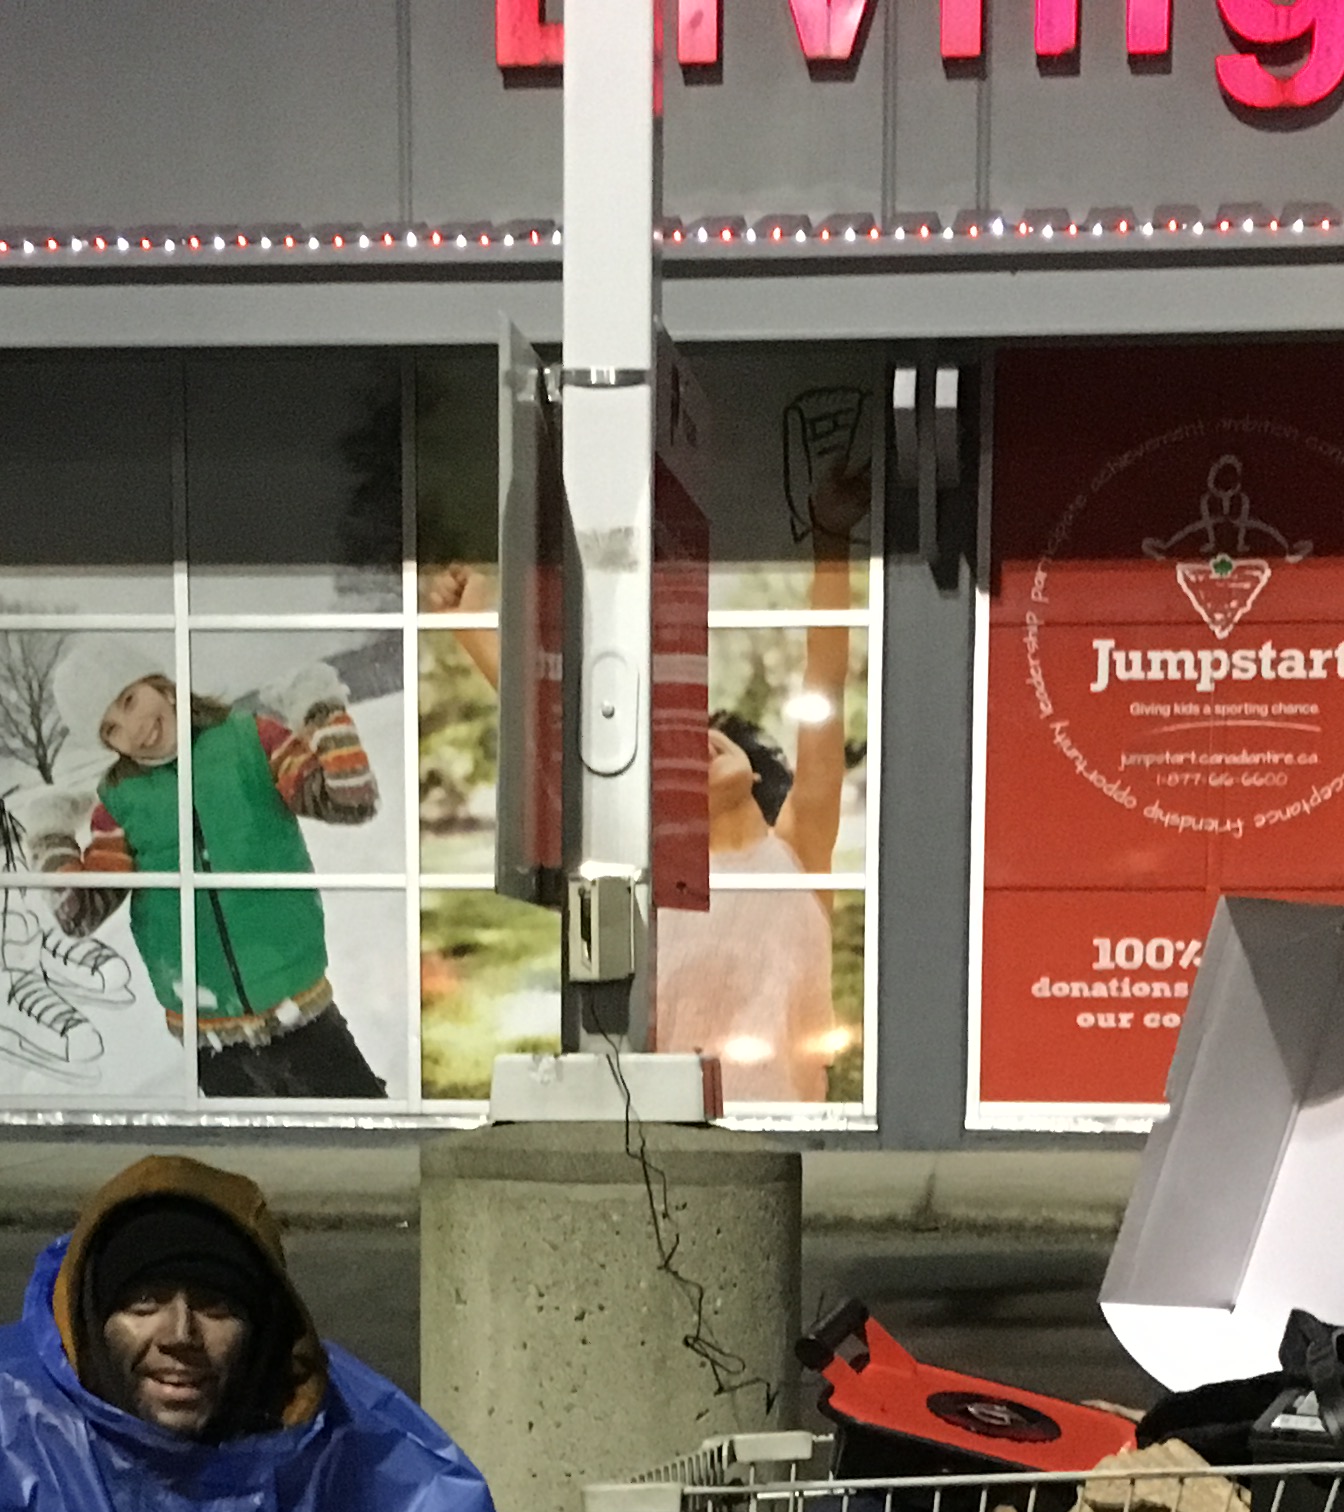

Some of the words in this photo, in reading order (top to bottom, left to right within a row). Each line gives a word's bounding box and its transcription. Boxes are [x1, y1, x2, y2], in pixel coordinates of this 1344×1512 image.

[1022, 611, 1054, 720] leadership
[1130, 702, 1171, 718] Giving
[1173, 702, 1200, 716] kids
[1202, 704, 1212, 716] a
[1213, 702, 1269, 718] sporting
[1050, 718, 1138, 811] opportunity
[1143, 800, 1244, 839] friendship
[1092, 936, 1203, 970] 100%
[1031, 977, 1189, 998] donations
[1076, 1011, 1134, 1029] our
